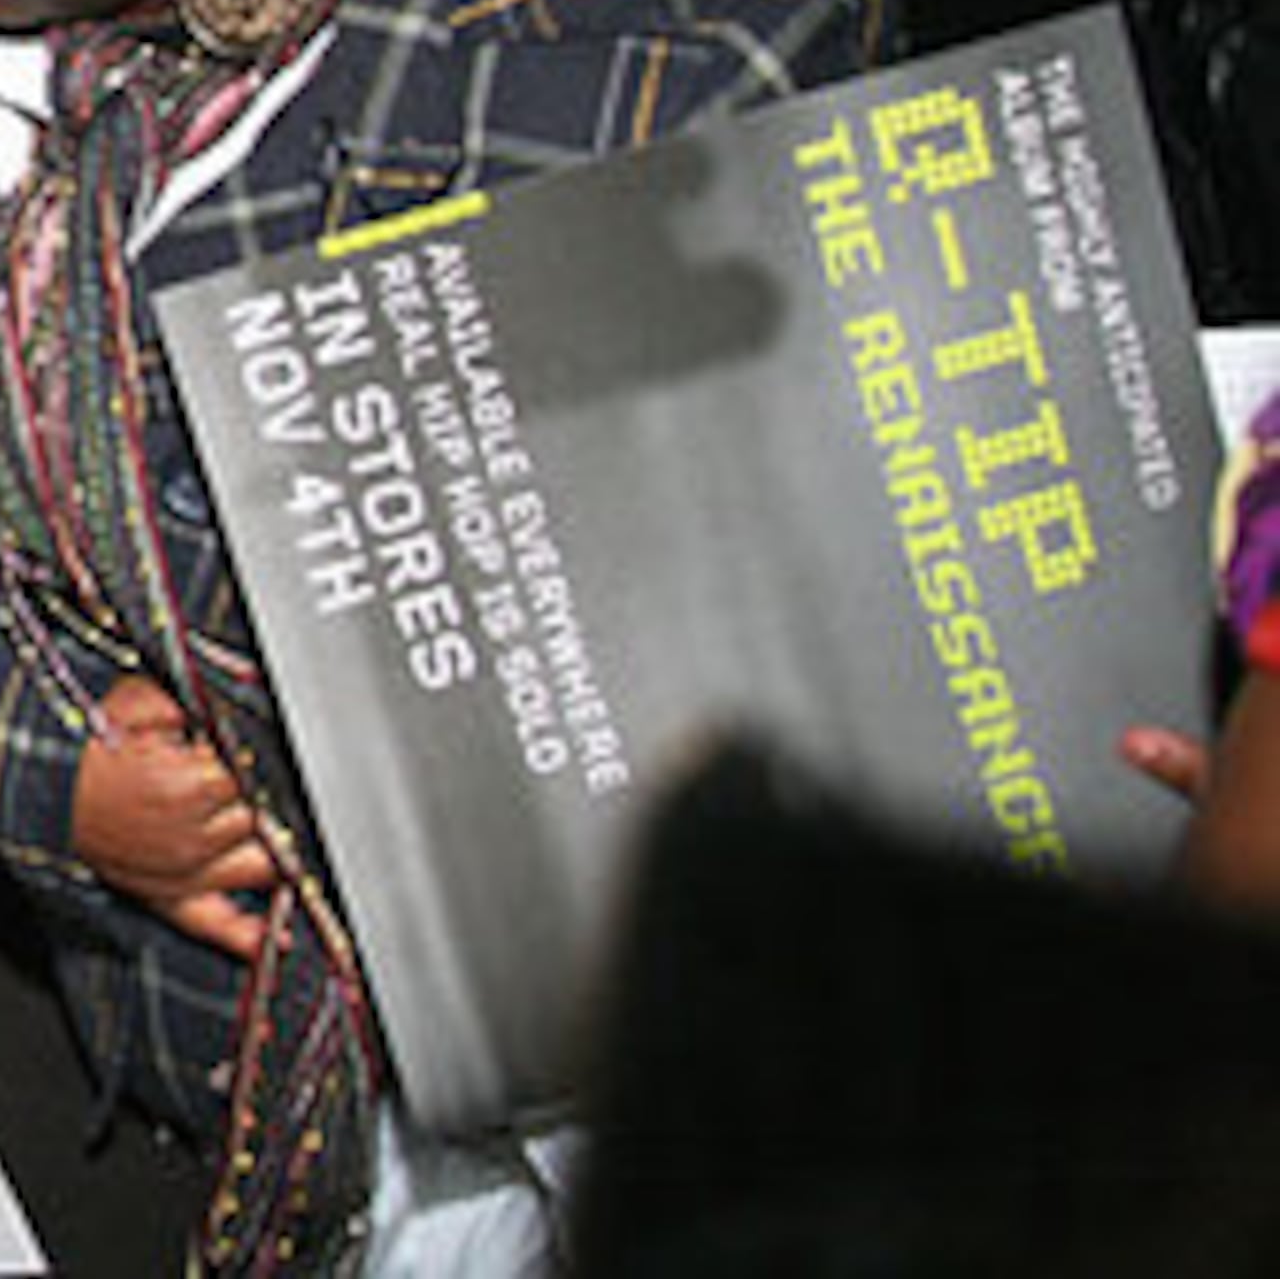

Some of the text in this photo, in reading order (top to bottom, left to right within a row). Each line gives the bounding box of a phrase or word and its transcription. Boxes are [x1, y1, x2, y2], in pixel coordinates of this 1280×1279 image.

[794, 114, 884, 288] THE
[993, 69, 1083, 310] ALBUM FROM
[372, 252, 439, 380] REAL
[870, 86, 1099, 592] Q-TIP
[224, 288, 377, 614] NOV 4TH
[293, 268, 478, 691] IN STORES
[410, 381, 475, 468] HIP
[423, 242, 631, 794] AVAILABLE EVERYWHERE
[442, 475, 506, 574] HOP
[474, 582, 525, 641] IS
